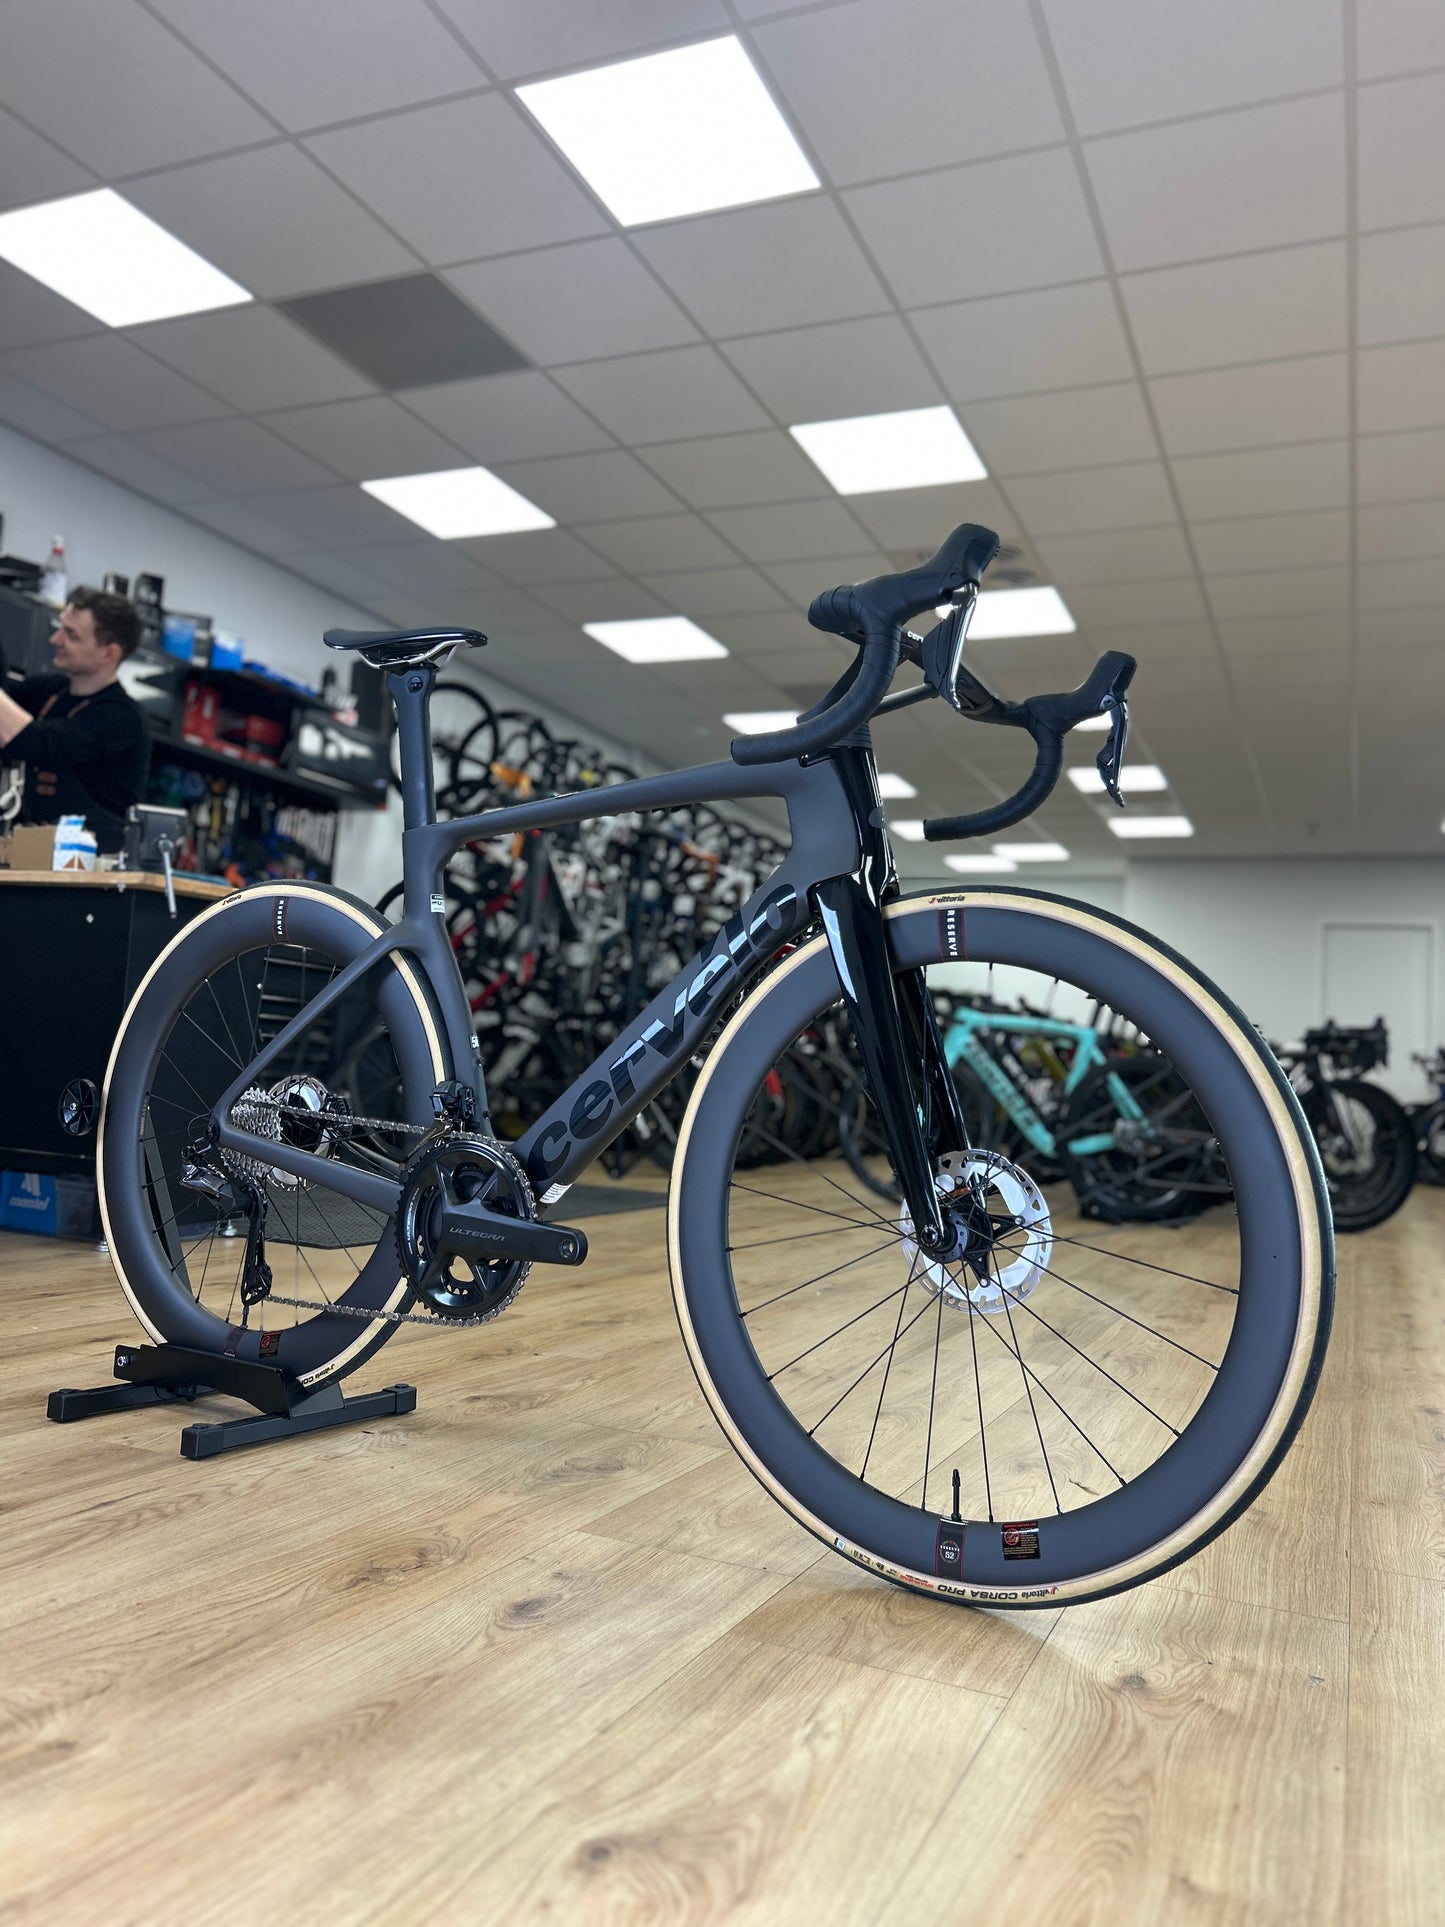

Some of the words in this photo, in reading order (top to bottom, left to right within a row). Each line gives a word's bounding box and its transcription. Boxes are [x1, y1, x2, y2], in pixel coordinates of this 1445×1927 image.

[937, 895, 966, 903] vittoria
[947, 910, 958, 957] RESERVE
[449, 1226, 505, 1242] ULTEGRA
[944, 1551, 955, 1560] 52
[937, 1584, 966, 1596] PRO
[970, 1590, 1018, 1600] CORSA
[1021, 1589, 1050, 1600] vittoria
